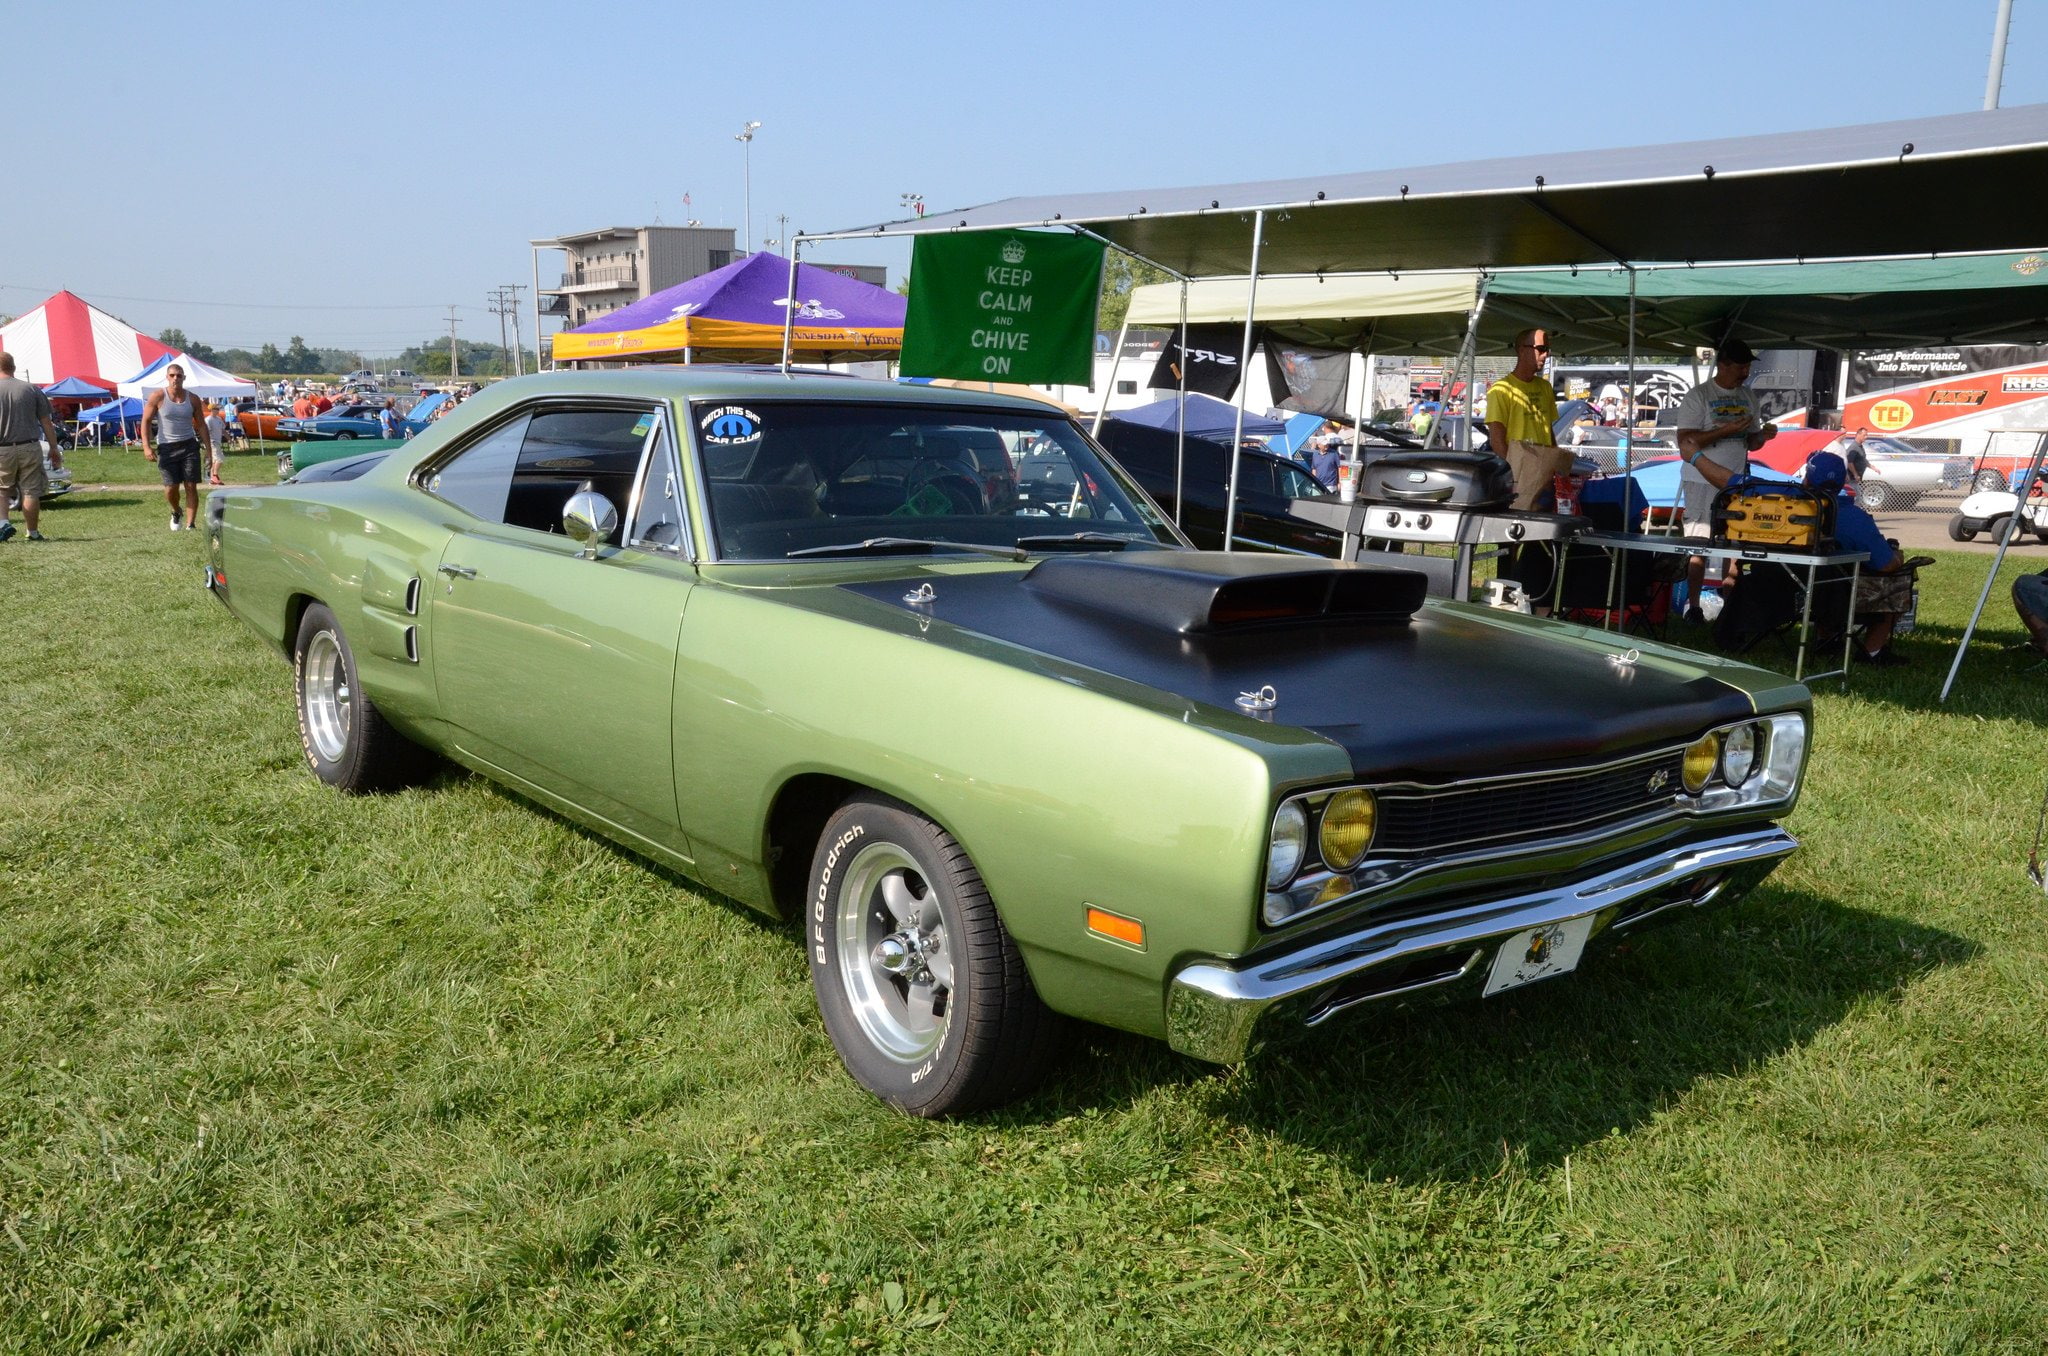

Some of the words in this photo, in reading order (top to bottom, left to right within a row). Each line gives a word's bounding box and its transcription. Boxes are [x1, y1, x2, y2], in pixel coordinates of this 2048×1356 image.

[987, 266, 1032, 287] KEEP
[979, 291, 1032, 312] CALM
[993, 316, 1014, 326] AND
[971, 329, 1030, 351] CHIVE
[1894, 351, 1961, 361] Performance
[983, 355, 1011, 375] ON
[1877, 362, 1899, 371] Into
[1899, 362, 1929, 373] Every
[1930, 362, 1968, 371] Vehicle
[2006, 376, 2048, 389] RHS
[1933, 391, 1983, 404] FAST
[701, 407, 724, 430] WATCH
[725, 406, 744, 415] THIS
[745, 409, 761, 425] SHIT
[1874, 406, 1904, 422] TCI
[705, 434, 729, 444] CAR
[732, 431, 761, 444] CLUB
